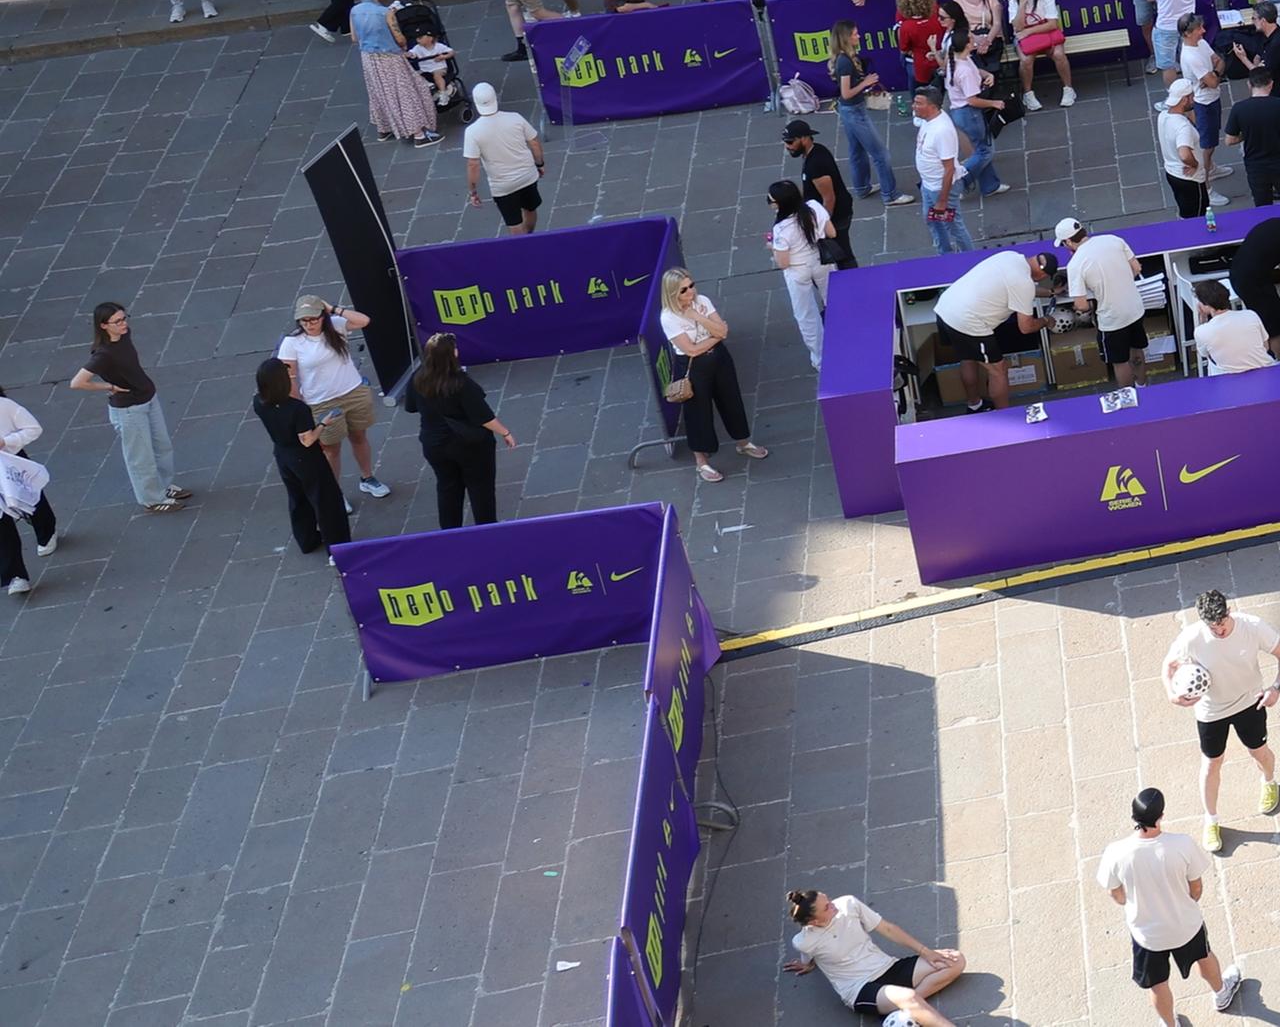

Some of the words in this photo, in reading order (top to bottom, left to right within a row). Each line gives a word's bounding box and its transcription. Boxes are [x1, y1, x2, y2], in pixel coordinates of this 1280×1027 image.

[1083, 0, 1125, 28] park
[799, 35, 830, 56] her
[616, 50, 664, 79] park
[441, 291, 495, 319] hero
[506, 279, 564, 314] park
[387, 589, 455, 619] hero
[467, 574, 538, 613] park
